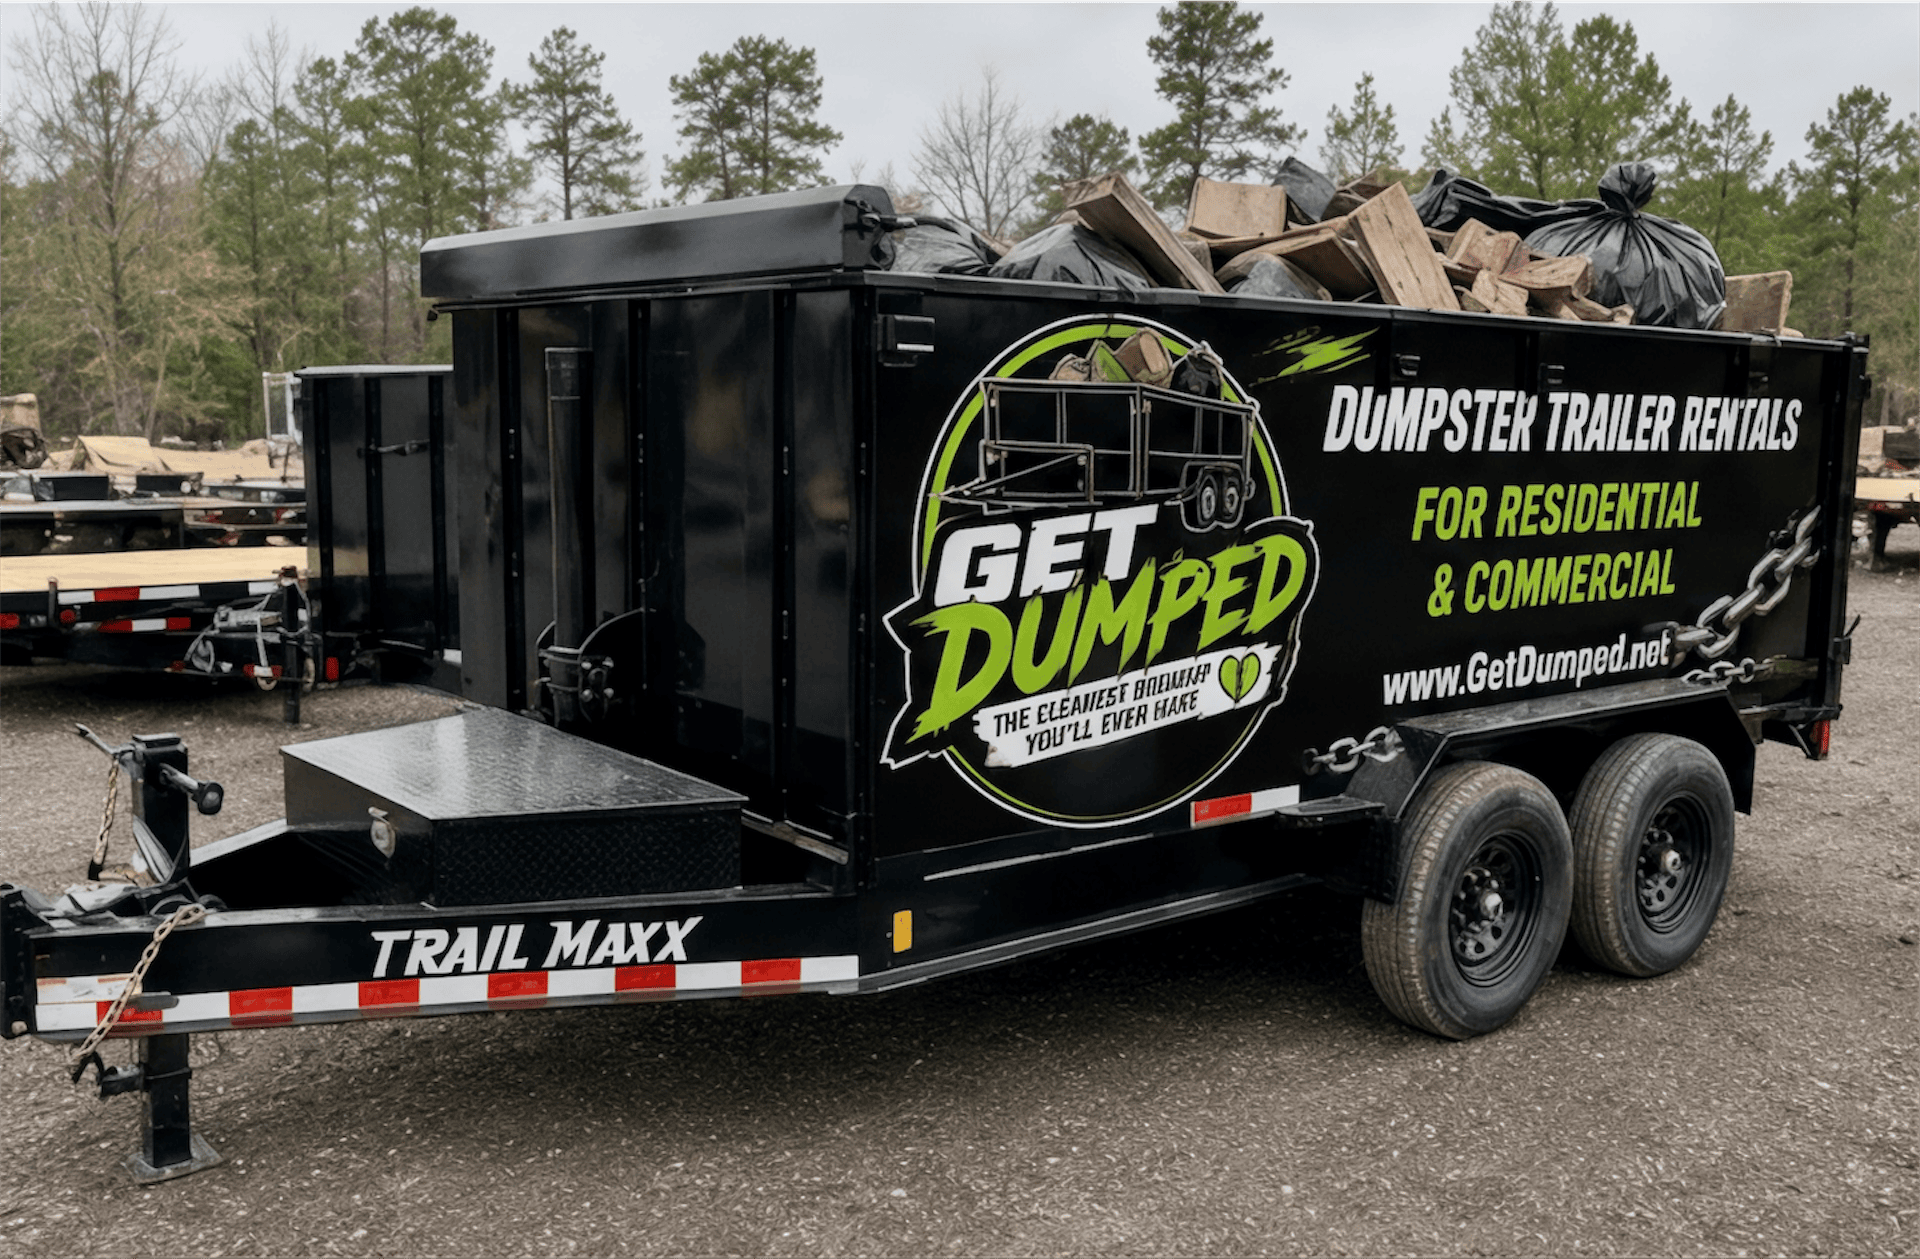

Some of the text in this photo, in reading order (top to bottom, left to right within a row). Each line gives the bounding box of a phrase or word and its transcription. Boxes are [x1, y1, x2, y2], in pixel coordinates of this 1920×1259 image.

[1323, 385, 1803, 452] DUMPSTER TRAILER RENTALS
[1411, 481, 1702, 541] FOR RESIDENTIAL
[934, 503, 1159, 607] GET
[1427, 548, 1676, 617] & COMMERCIAL
[905, 532, 1307, 744] DUMPED
[1383, 628, 1671, 705] www.GetDumped.net
[993, 706, 1031, 737] THE
[1025, 718, 1093, 756] YOU'LL
[1100, 702, 1148, 736] EVER
[371, 916, 703, 978] TRAIL MAXX
